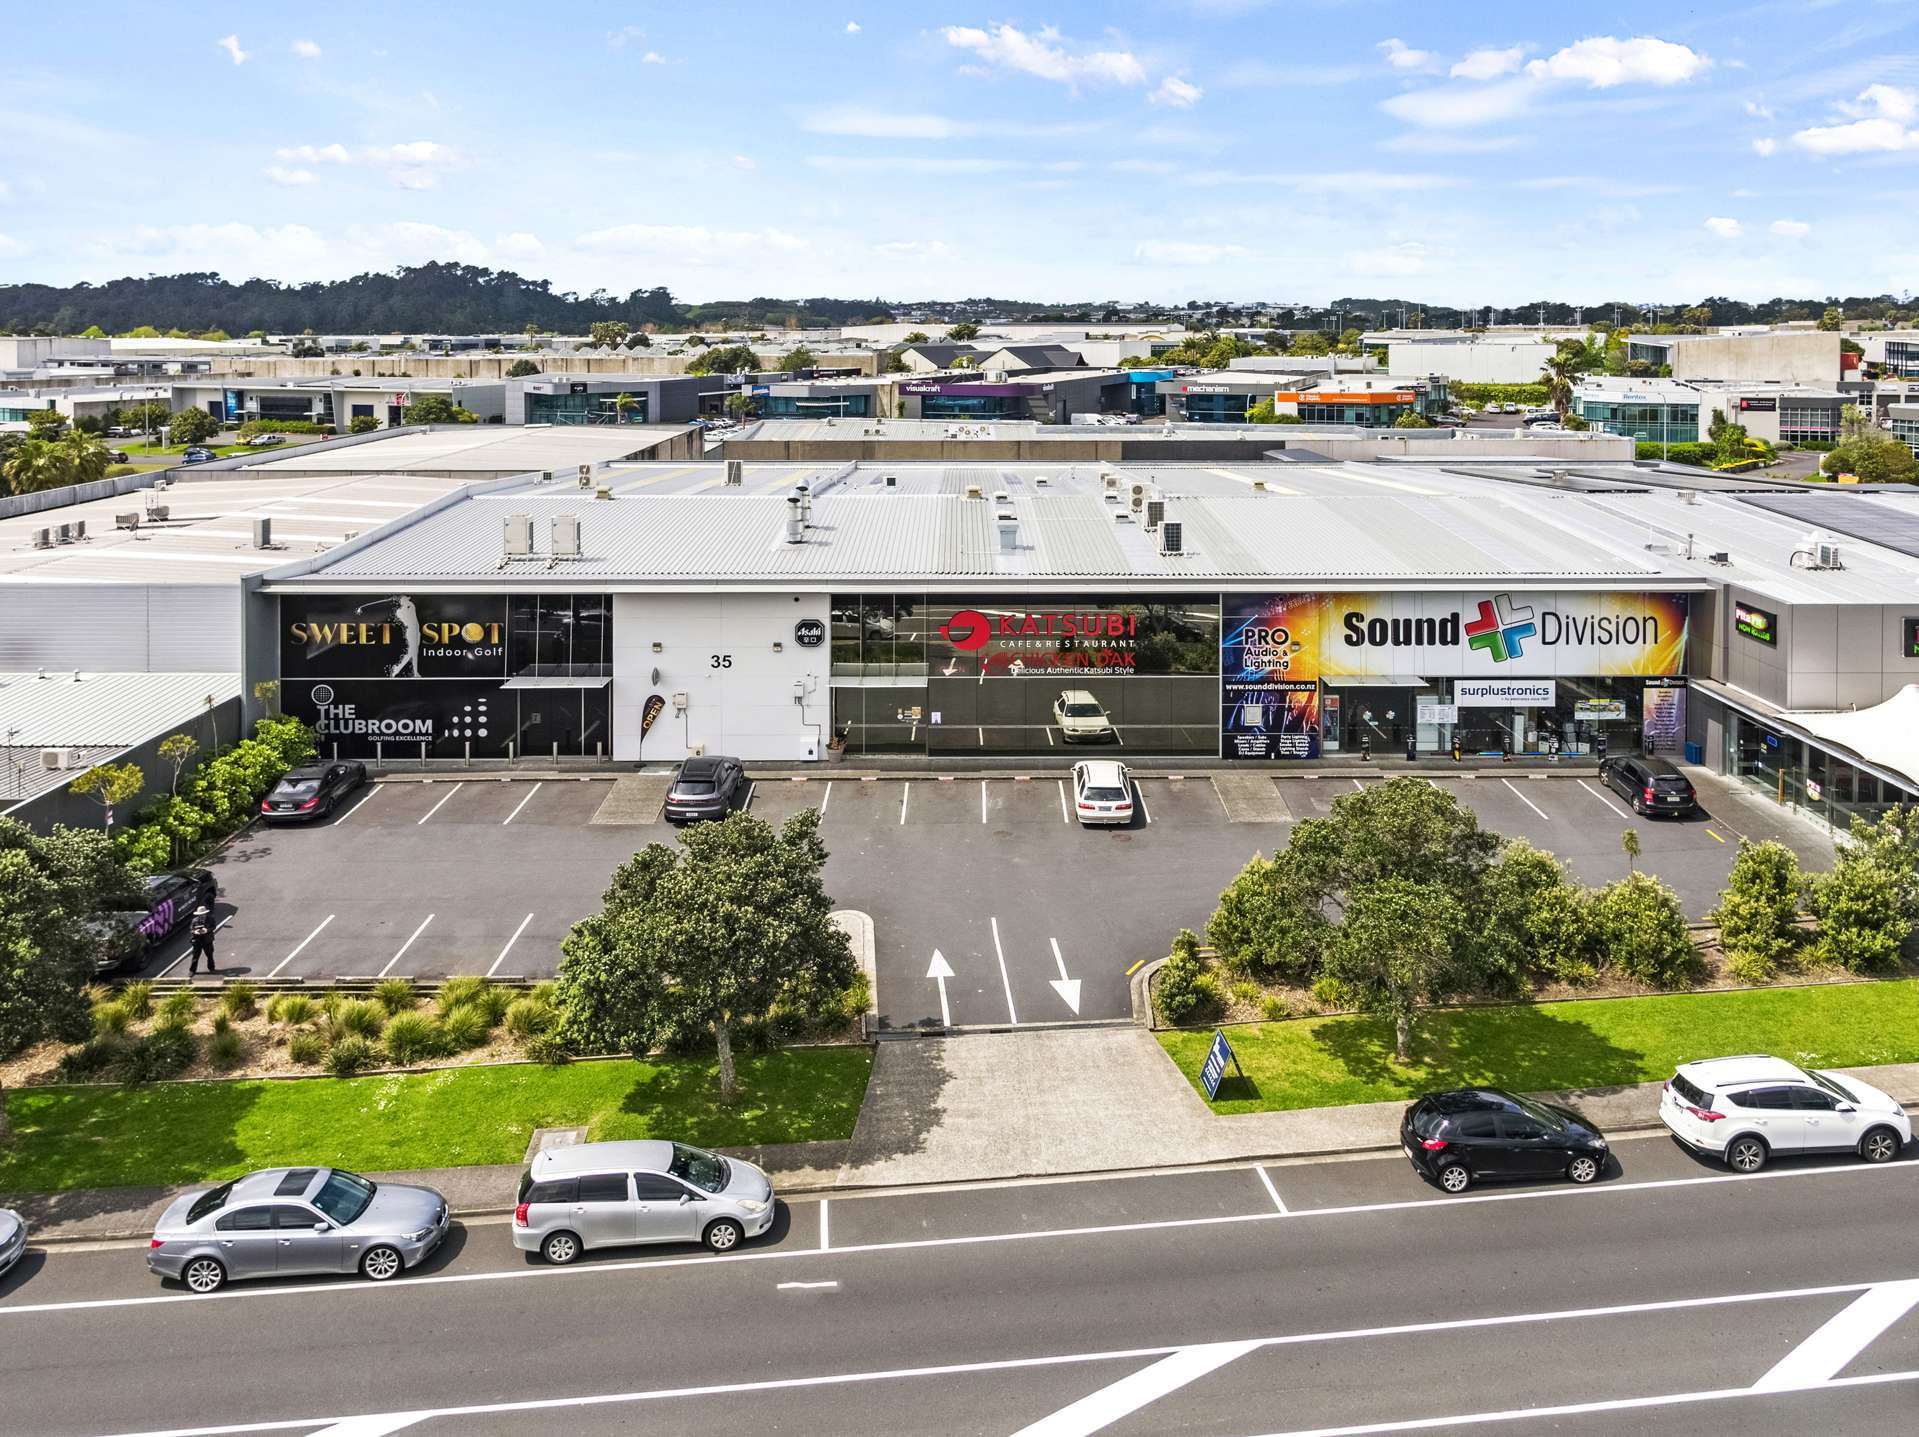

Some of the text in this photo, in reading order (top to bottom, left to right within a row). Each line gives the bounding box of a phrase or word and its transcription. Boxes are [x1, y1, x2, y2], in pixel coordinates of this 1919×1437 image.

[999, 613, 1135, 636] KATSUBI
[1344, 612, 1658, 647] Sound Division
[290, 622, 503, 645] SWEET SPOT
[1244, 628, 1289, 646] PRO
[423, 647, 503, 657] Indoor Golf
[1245, 647, 1278, 657] Audio
[711, 655, 732, 668] 35
[1244, 658, 1289, 670] Lighting
[1114, 667, 1134, 675] Style
[1460, 685, 1549, 697] surplustronics
[316, 704, 356, 719] THE
[643, 701, 663, 729] OPEN
[315, 719, 432, 734] CLUBROOM
